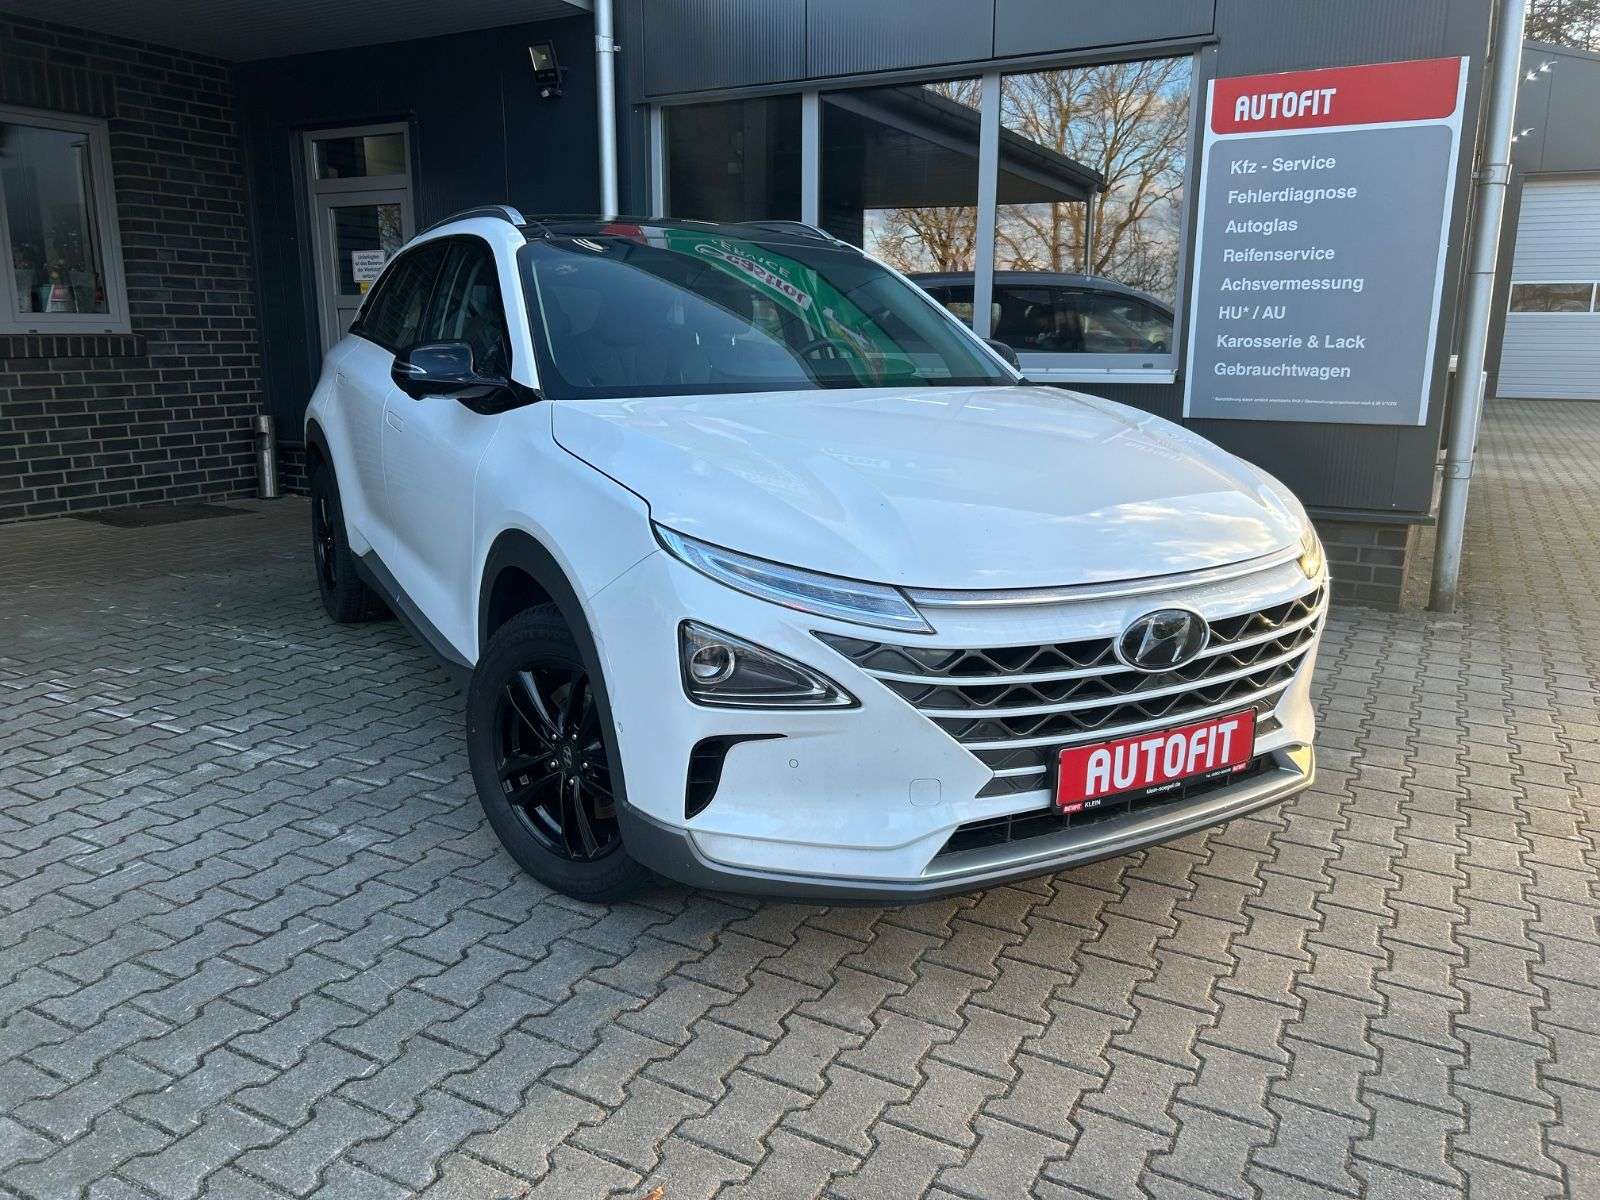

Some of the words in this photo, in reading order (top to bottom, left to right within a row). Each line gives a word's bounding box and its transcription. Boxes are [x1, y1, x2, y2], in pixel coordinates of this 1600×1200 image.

[1234, 88, 1336, 121] AUTOFIT
[1230, 160, 1257, 175] Kfz
[1272, 156, 1336, 172] Service
[1228, 185, 1358, 204] Fehlerdiagnose
[1225, 219, 1298, 236] Autoglas
[1223, 247, 1335, 263] Reifenservice
[1220, 277, 1364, 292] Achsvermessung
[1262, 306, 1286, 320] AU
[1216, 334, 1302, 349] Karosserie
[1307, 336, 1319, 349] &
[1325, 335, 1366, 350] Lack
[1214, 363, 1351, 379] Gebrauchtwagen
[1085, 720, 1238, 796] AUTOFIT
[1084, 799, 1101, 809] KLEIN
